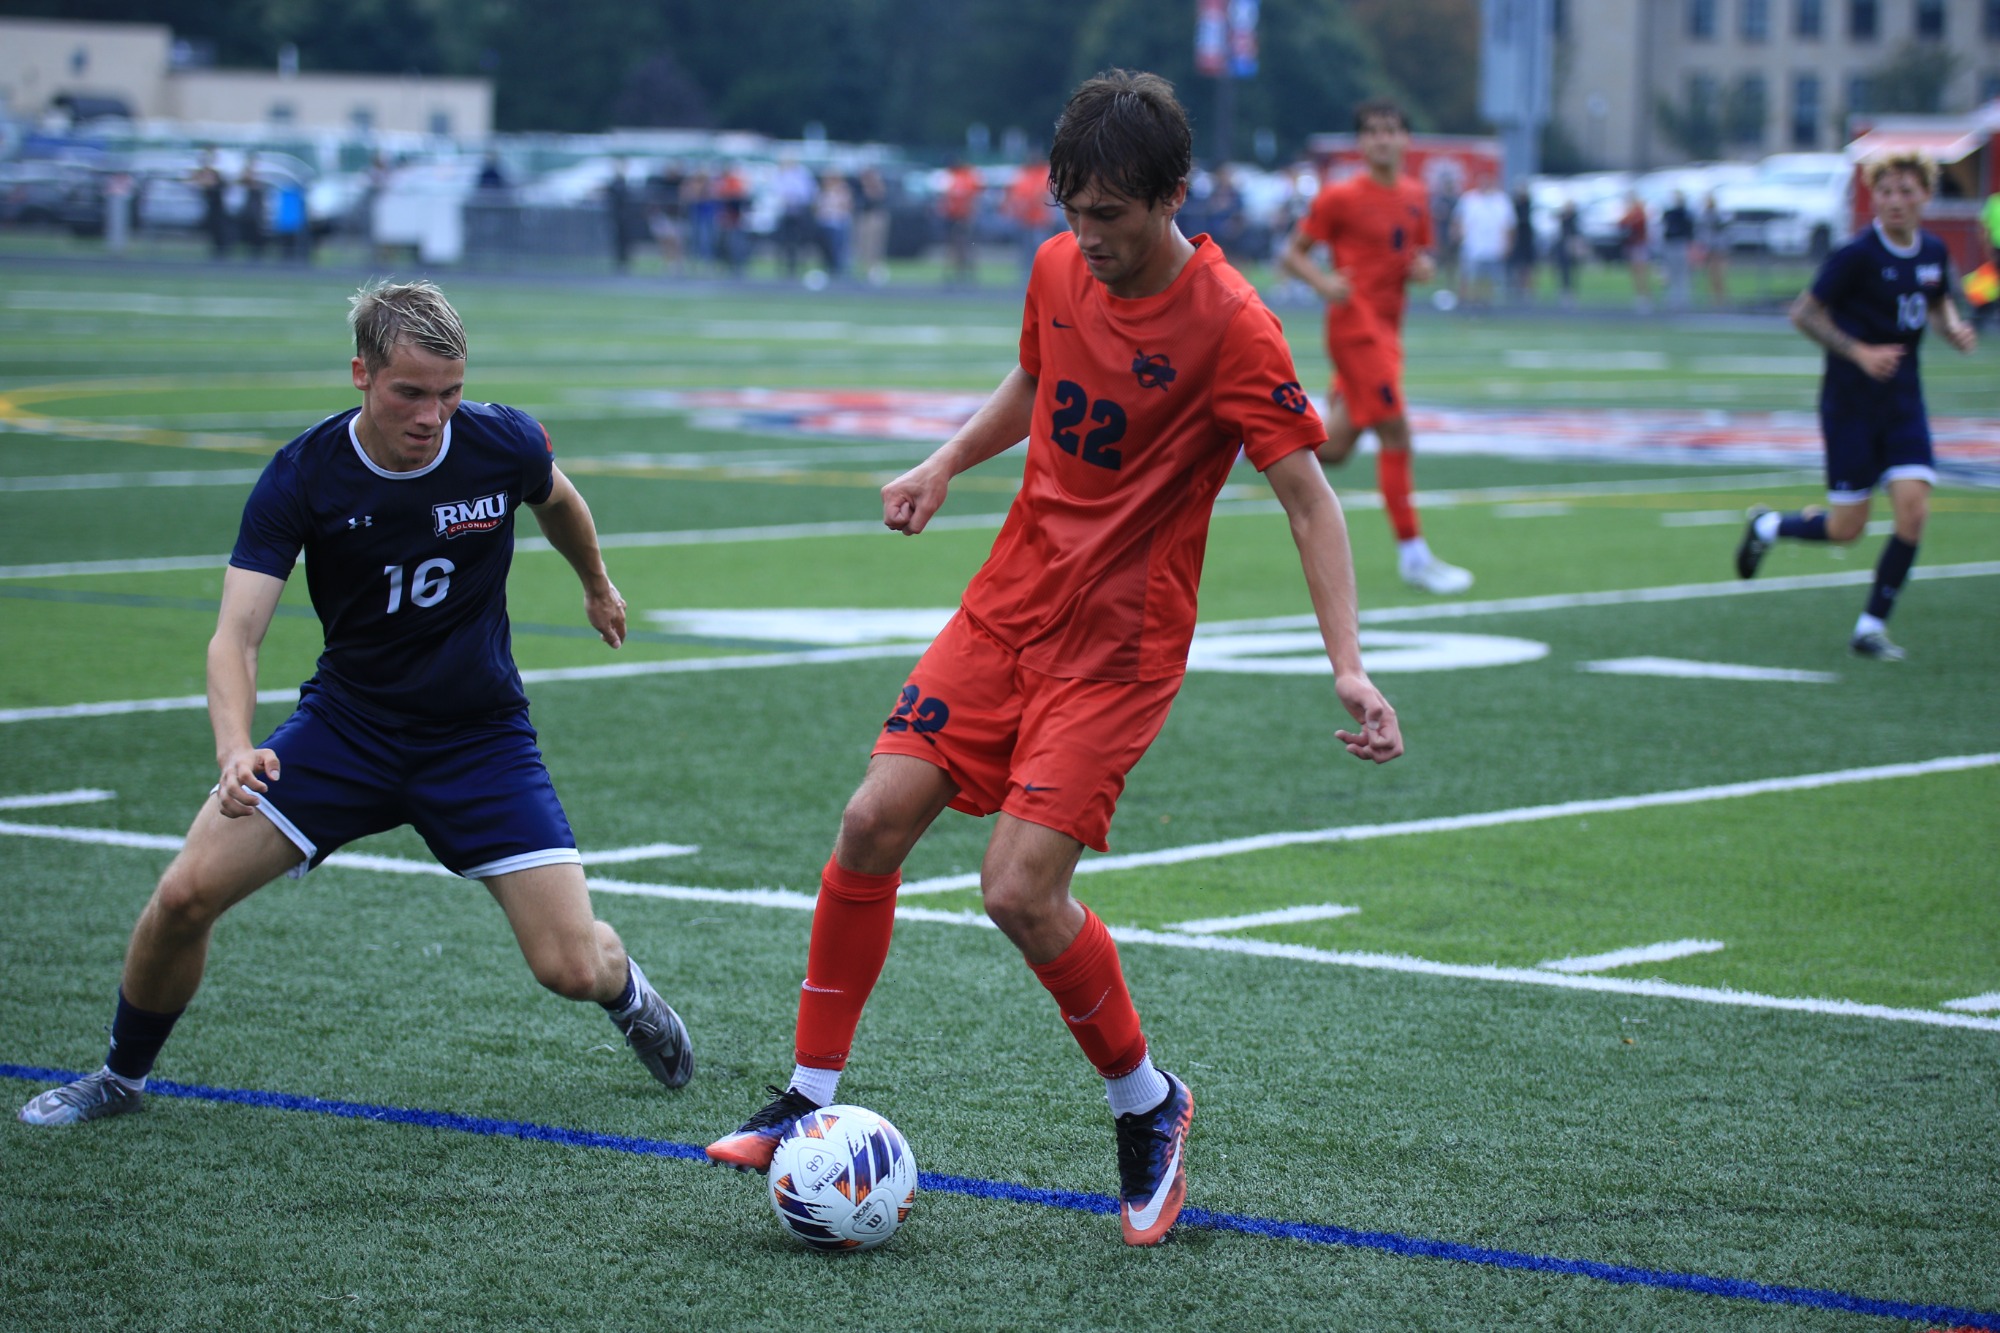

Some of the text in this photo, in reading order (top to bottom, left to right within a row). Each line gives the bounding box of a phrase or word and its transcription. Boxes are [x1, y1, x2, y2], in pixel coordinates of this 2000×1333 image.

[1896, 291, 1927, 332] 10
[1051, 379, 1127, 471] 22
[435, 493, 505, 532] RMU
[450, 520, 498, 533] COLONIALS
[384, 558, 455, 614] 16
[886, 684, 950, 746] 22
[805, 1154, 824, 1172] GB
[822, 1162, 844, 1183] UDM
[852, 1201, 873, 1221] NCAA
